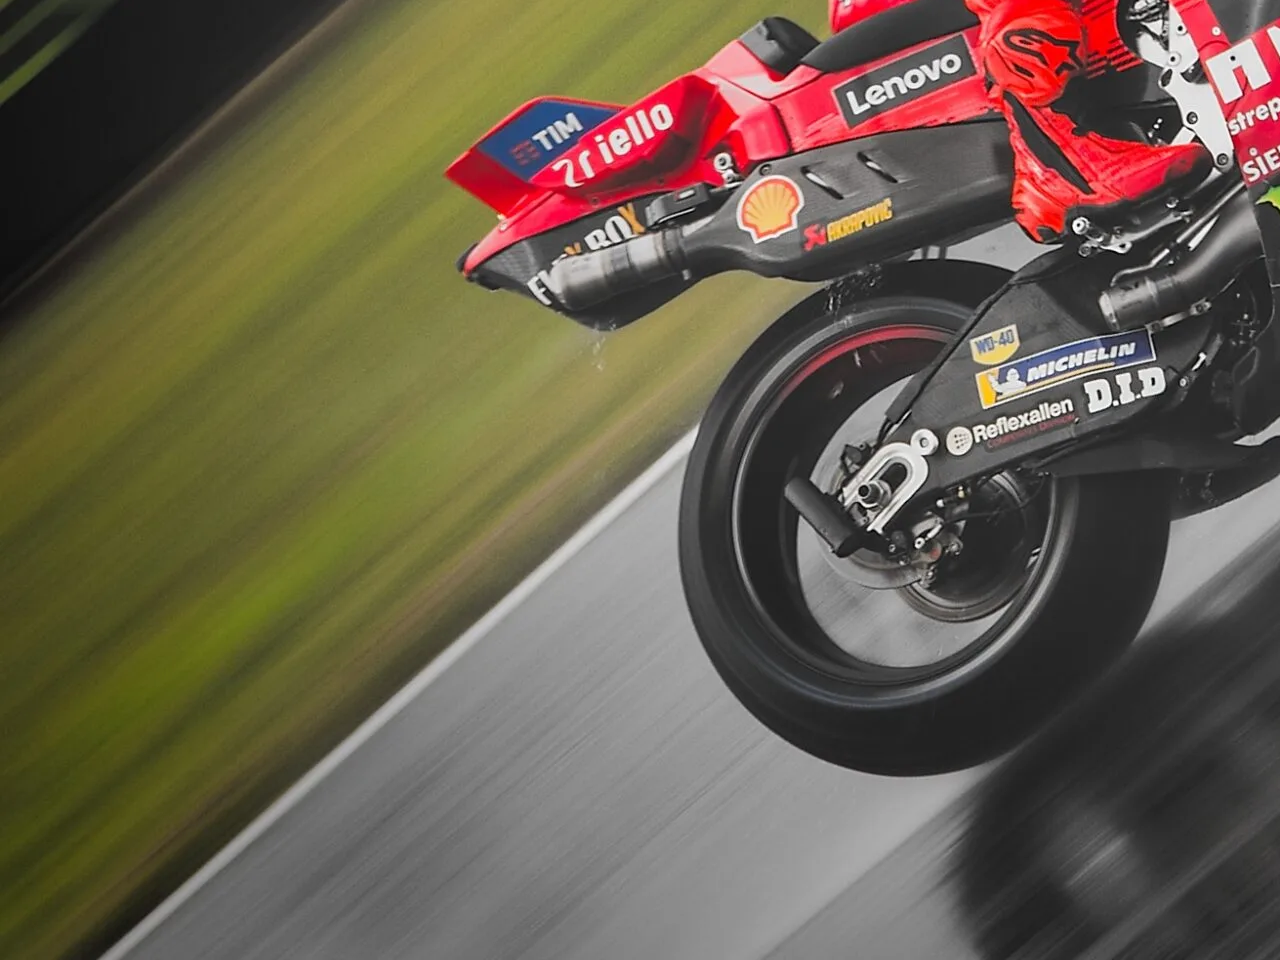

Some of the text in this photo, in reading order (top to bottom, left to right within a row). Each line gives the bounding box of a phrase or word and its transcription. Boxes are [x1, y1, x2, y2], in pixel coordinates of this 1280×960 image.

[846, 53, 962, 115] Lenovo
[532, 112, 584, 151] TIM
[974, 330, 1016, 355] WD-40
[1026, 342, 1137, 383] MICHELIN
[1083, 366, 1167, 414] D.I.D
[972, 398, 1075, 444] Reflexallen
